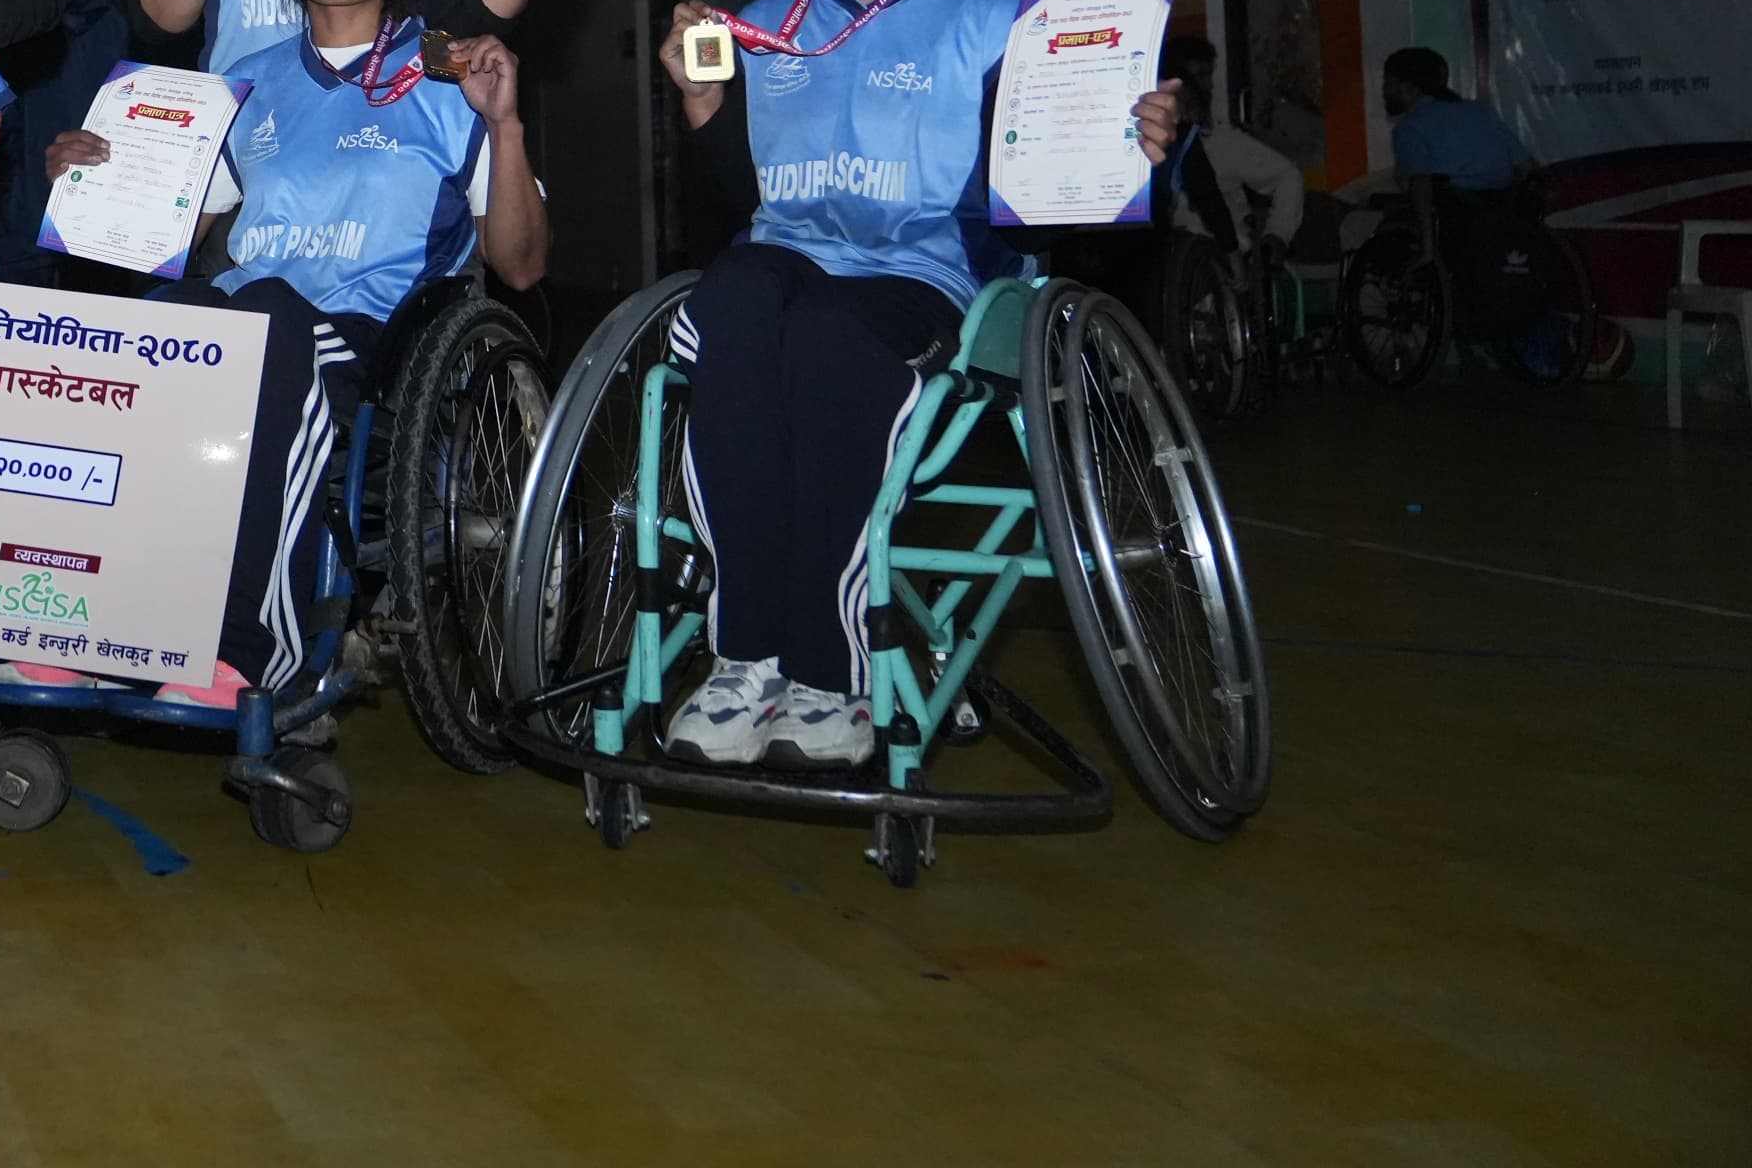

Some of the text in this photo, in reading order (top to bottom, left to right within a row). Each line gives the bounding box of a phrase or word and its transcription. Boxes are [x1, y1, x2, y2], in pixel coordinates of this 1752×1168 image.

[336, 127, 398, 153] NSCISA
[827, 151, 908, 202] SCHIM
[14, 548, 89, 571] व्यवस्थापन
[1, 627, 31, 647] कर्ड
[38, 631, 89, 657] इन्जुरी
[97, 638, 153, 670] खेलकुद
